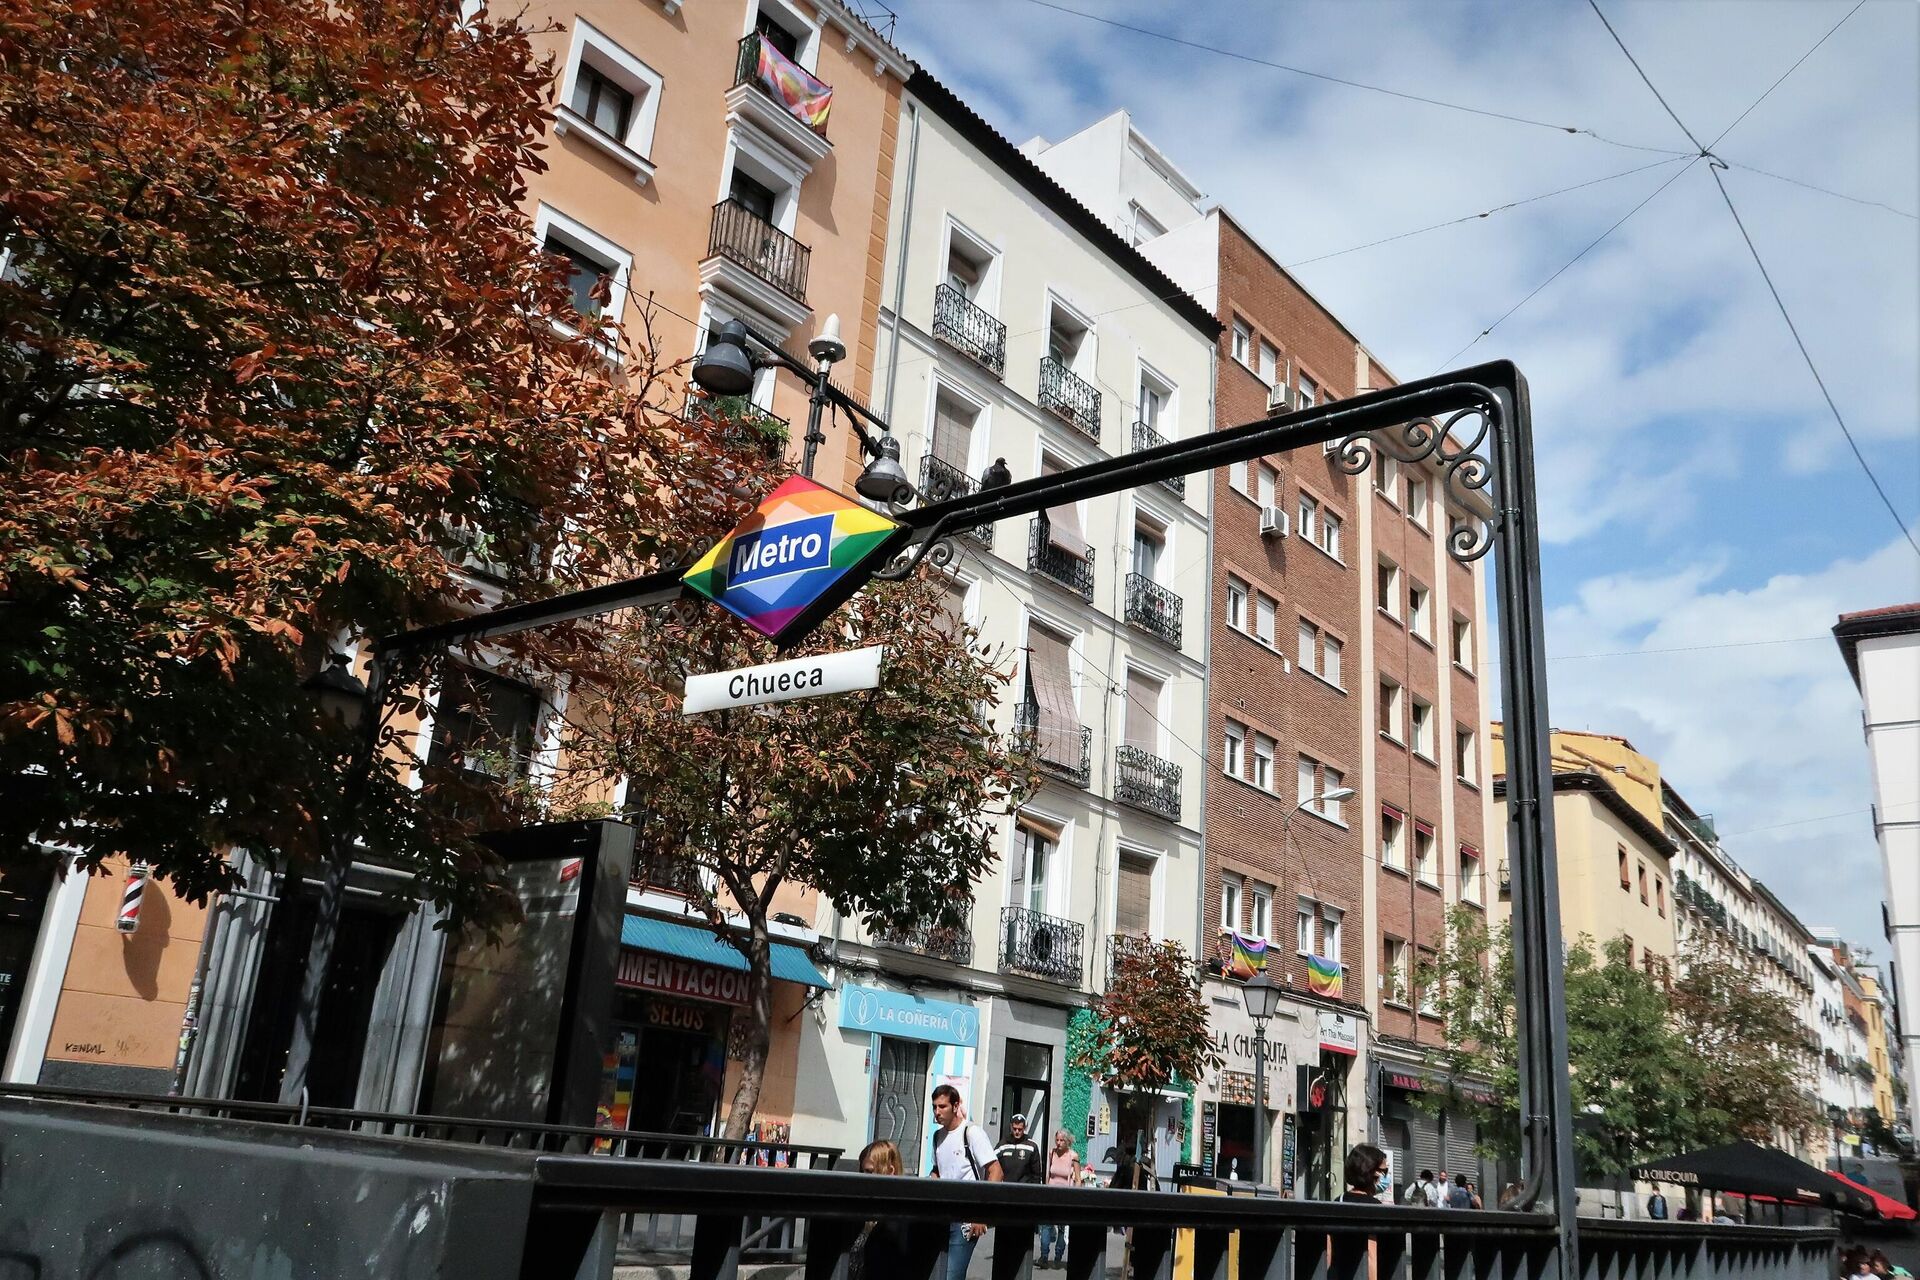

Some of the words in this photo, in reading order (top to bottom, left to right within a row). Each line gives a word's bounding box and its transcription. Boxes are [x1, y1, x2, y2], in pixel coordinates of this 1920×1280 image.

[735, 533, 822, 574] Metro
[729, 668, 823, 699] Chueca
[617, 952, 751, 1001] IMENTACION
[879, 1006, 894, 1021] LA
[897, 1009, 949, 1031] COÑERÍA
[1215, 1030, 1229, 1054] LA
[1638, 1169, 1650, 1179] LA
[1650, 1169, 1699, 1184] CHUEQUITA
